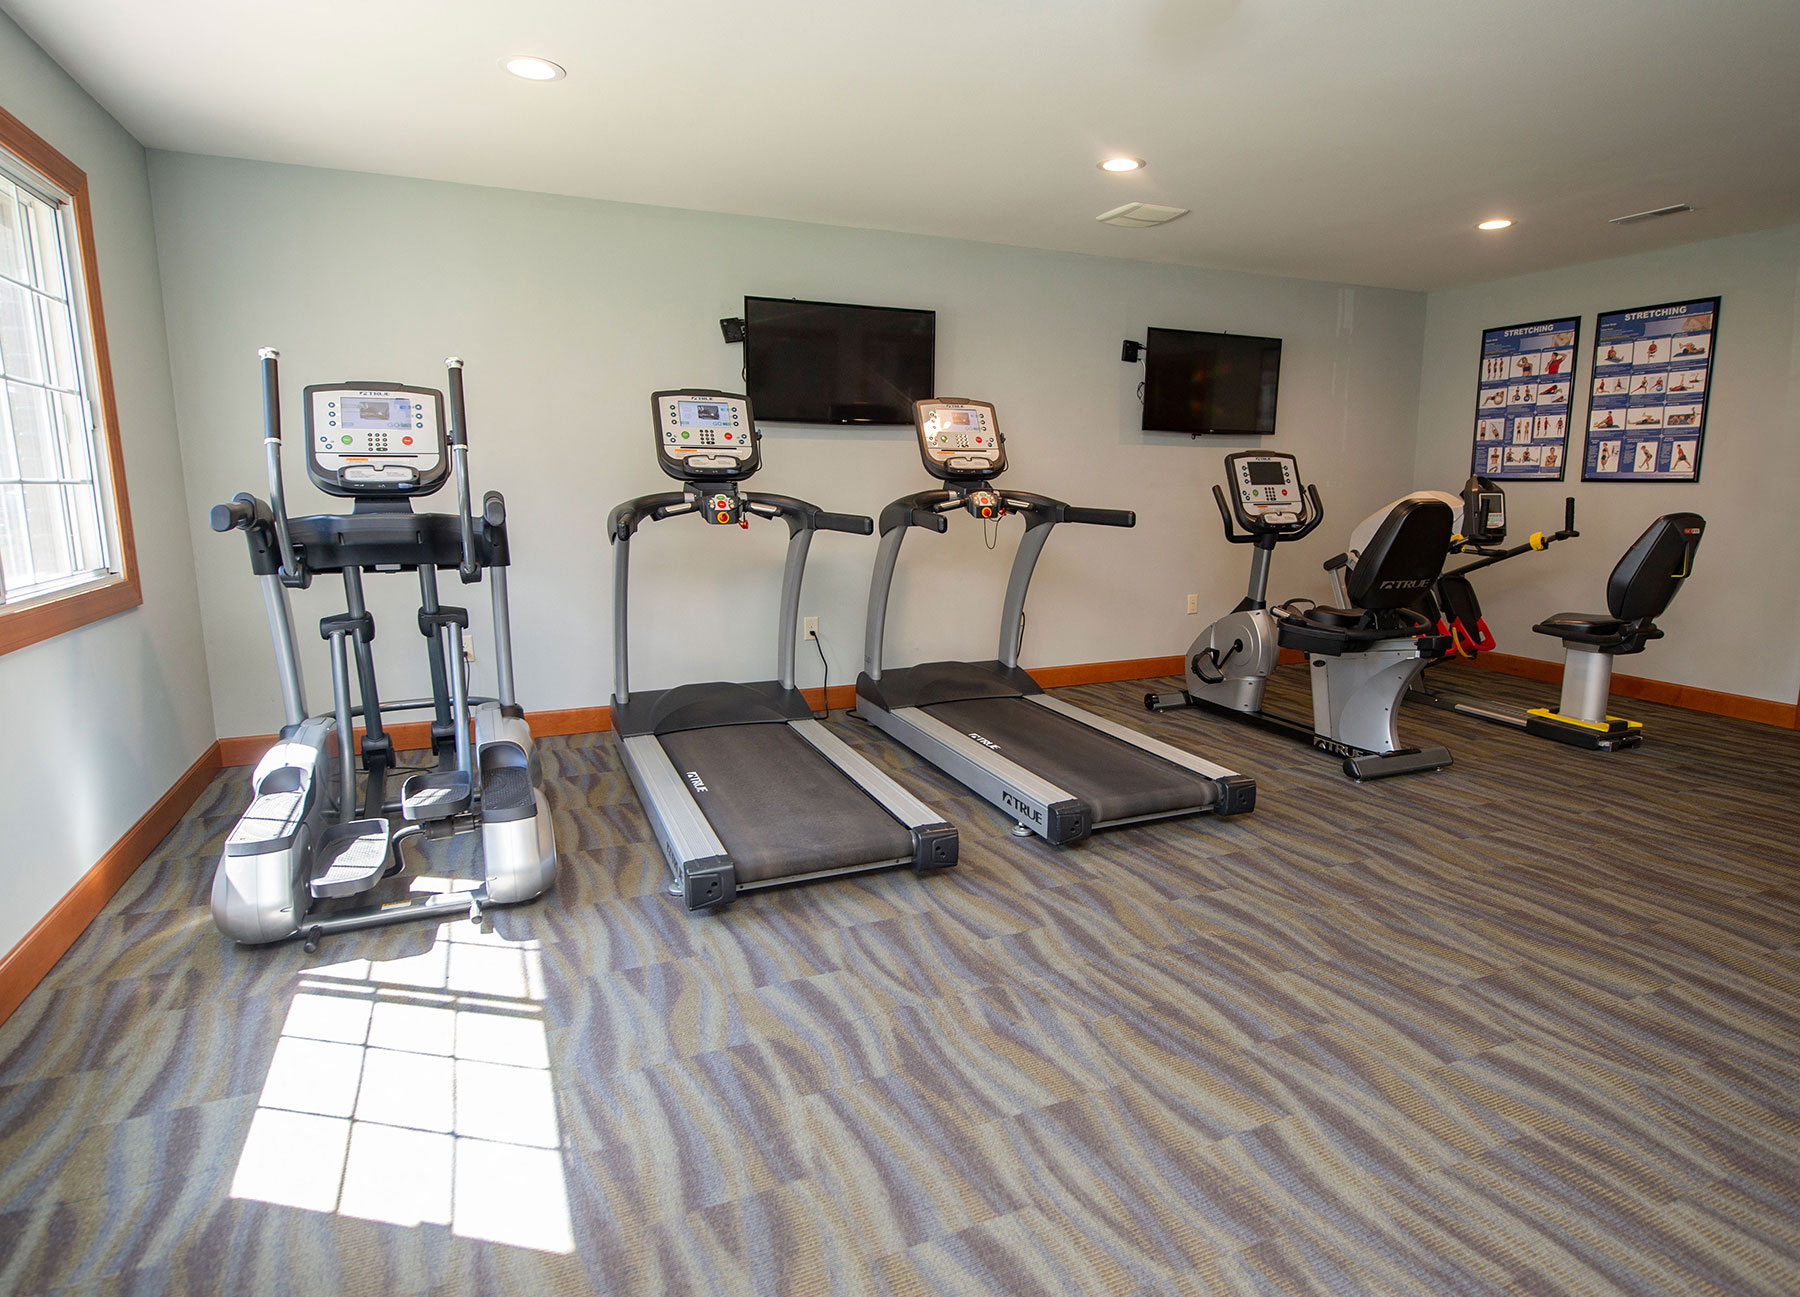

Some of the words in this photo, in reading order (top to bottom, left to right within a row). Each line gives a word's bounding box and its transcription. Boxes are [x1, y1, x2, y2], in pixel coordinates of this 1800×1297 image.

[1624, 306, 1687, 321] STRETCHING
[1504, 324, 1554, 337] STRETCHING
[1395, 579, 1430, 589] TRUE
[977, 736, 1001, 750] TRUE
[1327, 741, 1364, 758] TRUE
[691, 777, 708, 793] TRUE
[1013, 796, 1042, 825] TRUE
